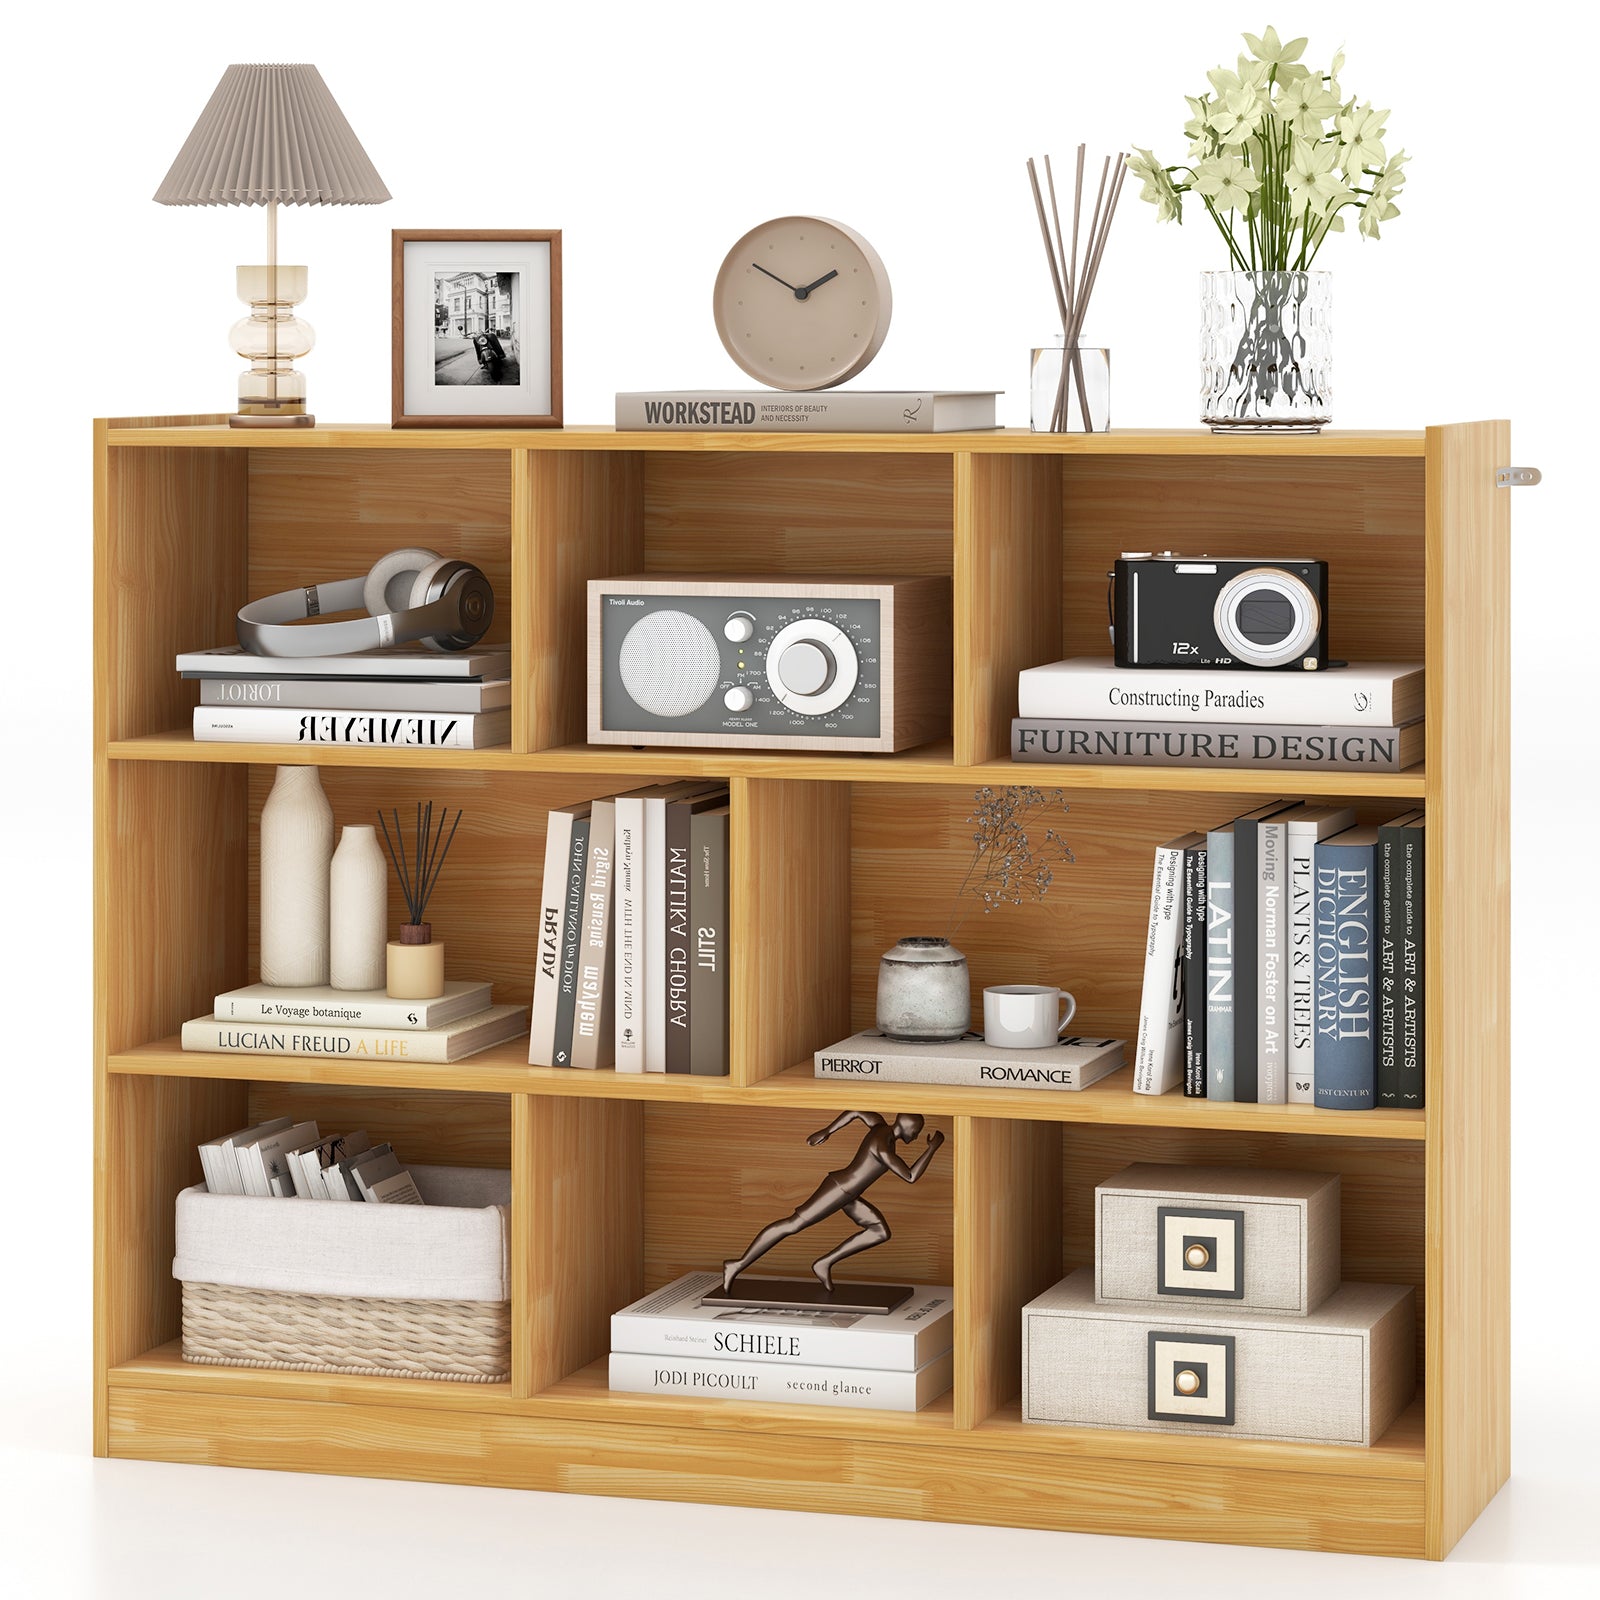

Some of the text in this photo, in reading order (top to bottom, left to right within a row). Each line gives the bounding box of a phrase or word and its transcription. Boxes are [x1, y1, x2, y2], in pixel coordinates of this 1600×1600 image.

[644, 401, 756, 425] WORKSTEAD
[760, 405, 828, 413] INTERIORS OF BEAUTY
[760, 414, 810, 422] AND NECESSITY
[1172, 642, 1199, 655] 12x
[217, 683, 281, 701] LORIOT
[1109, 687, 1265, 712] Constructing Paradies
[1018, 728, 1395, 763] FURNITURE DESIGN
[1164, 851, 1179, 920] Designing with type
[1196, 852, 1207, 921] Designing with type
[1383, 860, 1391, 898] complete
[1405, 861, 1413, 899] complete
[1383, 899, 1391, 924] guide
[1405, 900, 1413, 925] guide
[1184, 924, 1193, 960] Typography
[1208, 882, 1232, 1002] LATIN
[1262, 826, 1279, 1054] Moving Norman Foster on Art
[1384, 925, 1391, 934] to
[1406, 926, 1413, 935] to
[1293, 857, 1311, 1049] PLANTS & TREES
[1318, 867, 1337, 1041] DICTIONARY
[1338, 867, 1370, 1040] ENGLISH
[1383, 937, 1394, 974] ART
[1405, 938, 1416, 975] ART
[1383, 977, 1394, 992] &
[1405, 978, 1416, 993] &
[261, 1004, 362, 1021] Le Voyage botanique
[1383, 994, 1394, 1067] ARTISTS
[1405, 995, 1416, 1068] ARTISTS
[218, 1031, 409, 1056] LUCIAN FREUD A LIFE
[821, 1058, 883, 1075] PIERROT
[980, 1066, 1072, 1084] ROMANCE
[1333, 1089, 1371, 1097] CENTURY
[713, 1332, 801, 1356] SCHIELE
[653, 1369, 759, 1390] JODI PICOULT
[786, 1379, 872, 1396] second glance
